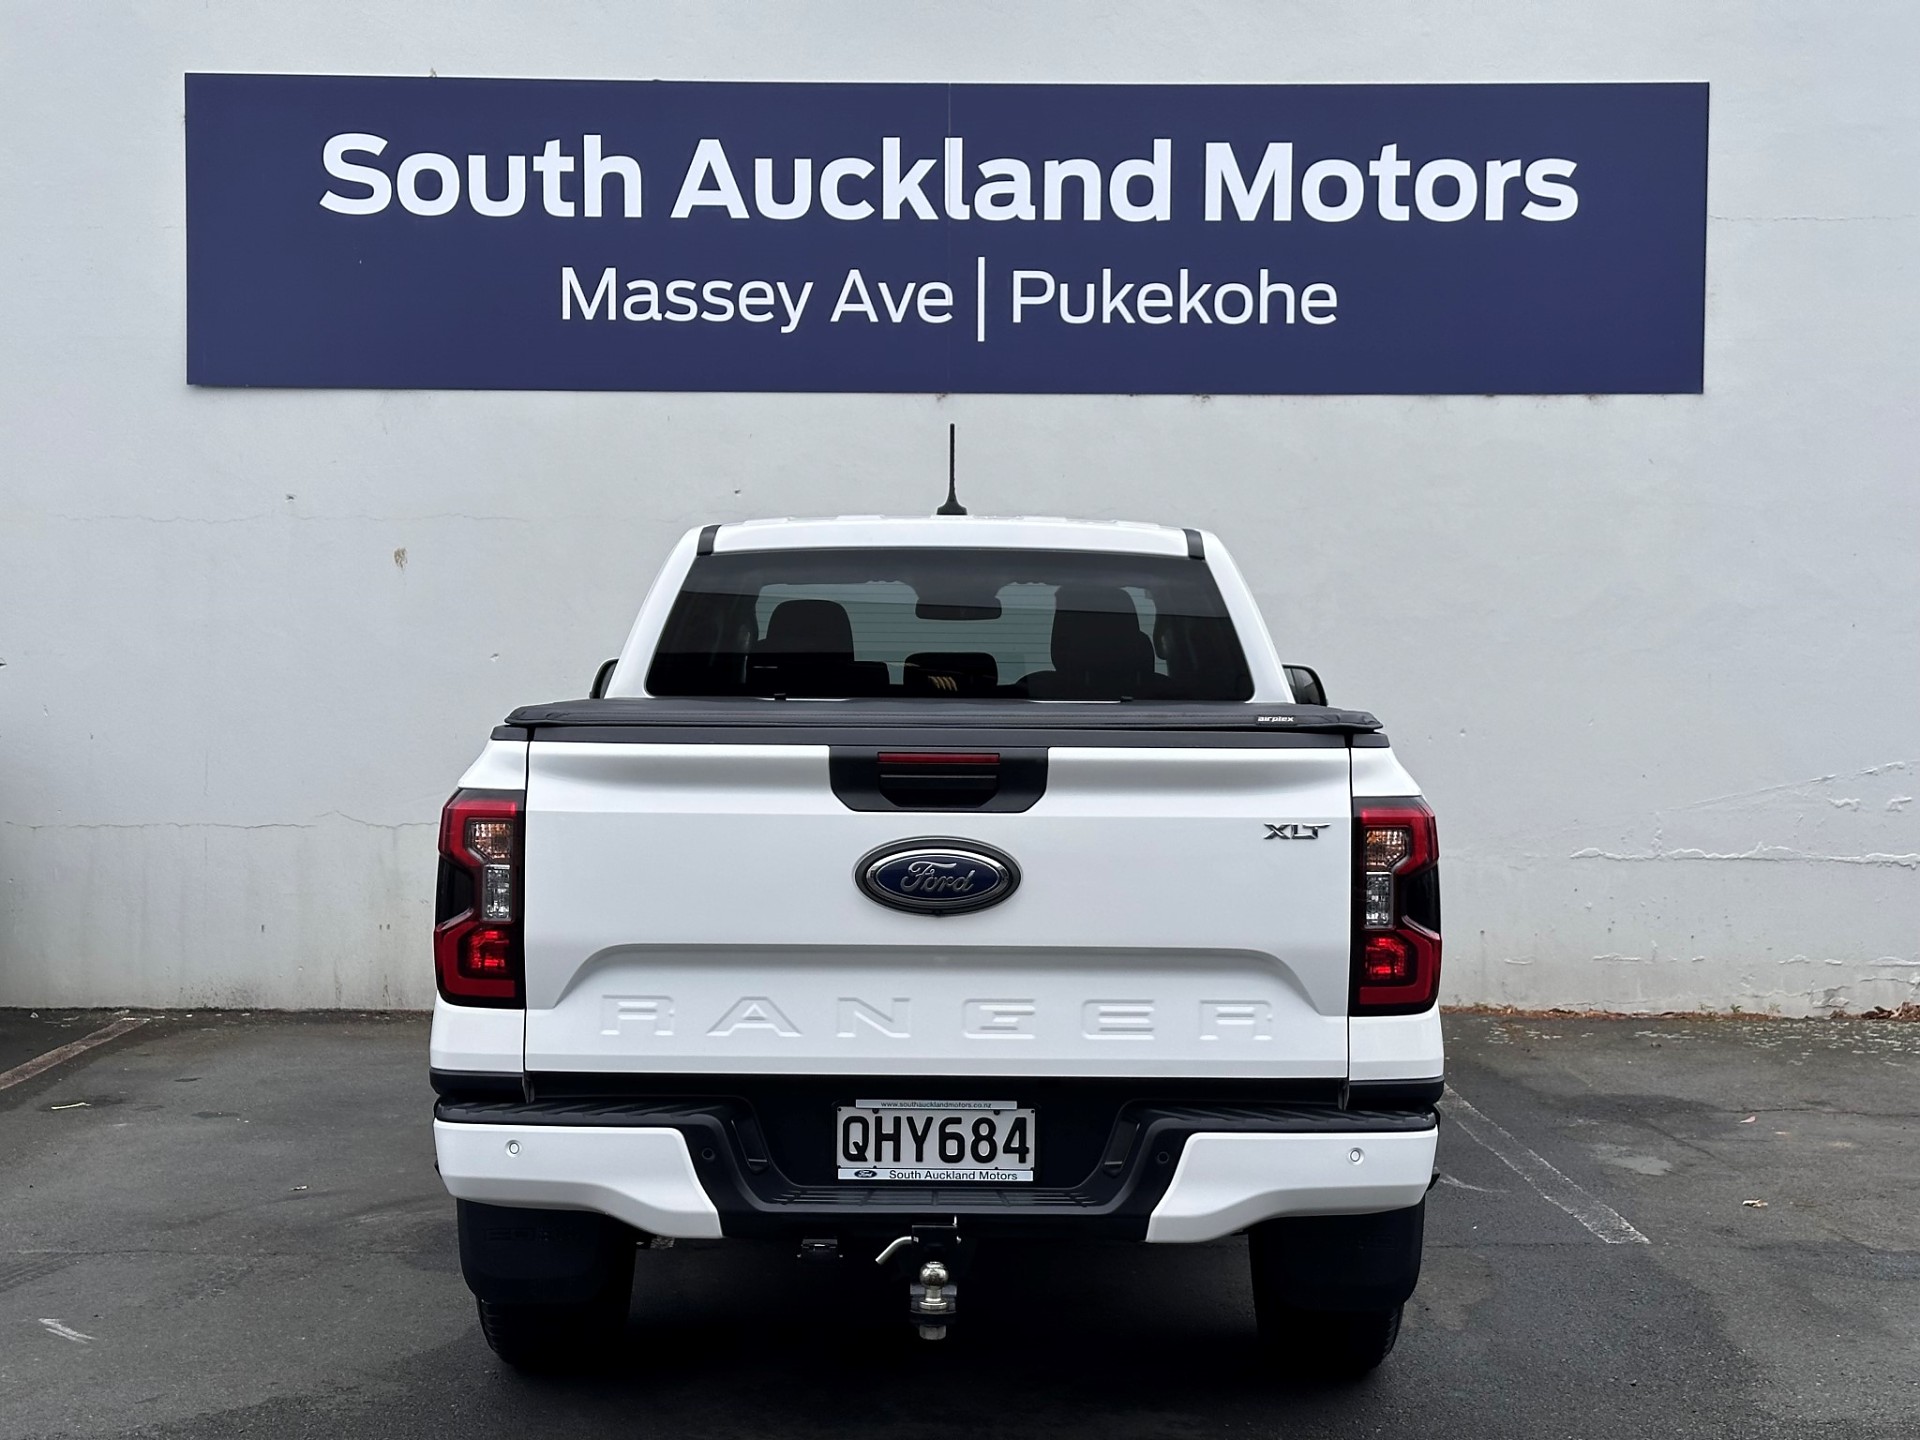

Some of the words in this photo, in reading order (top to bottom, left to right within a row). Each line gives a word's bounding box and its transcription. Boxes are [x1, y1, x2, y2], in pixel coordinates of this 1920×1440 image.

[319, 133, 642, 218] South
[670, 137, 1172, 222] Auckland
[1204, 142, 1579, 223] Motors
[562, 266, 814, 334] Massey
[830, 269, 954, 324] Ave
[1012, 268, 1338, 325] Pukekohe
[1263, 822, 1331, 840] XLT
[899, 860, 976, 893] Ford
[599, 993, 1275, 1041] RANGER
[842, 1115, 1030, 1164] QHY684
[888, 1169, 922, 1180] South
[924, 1170, 976, 1180] Auckland
[979, 1171, 1018, 1181] Motors
